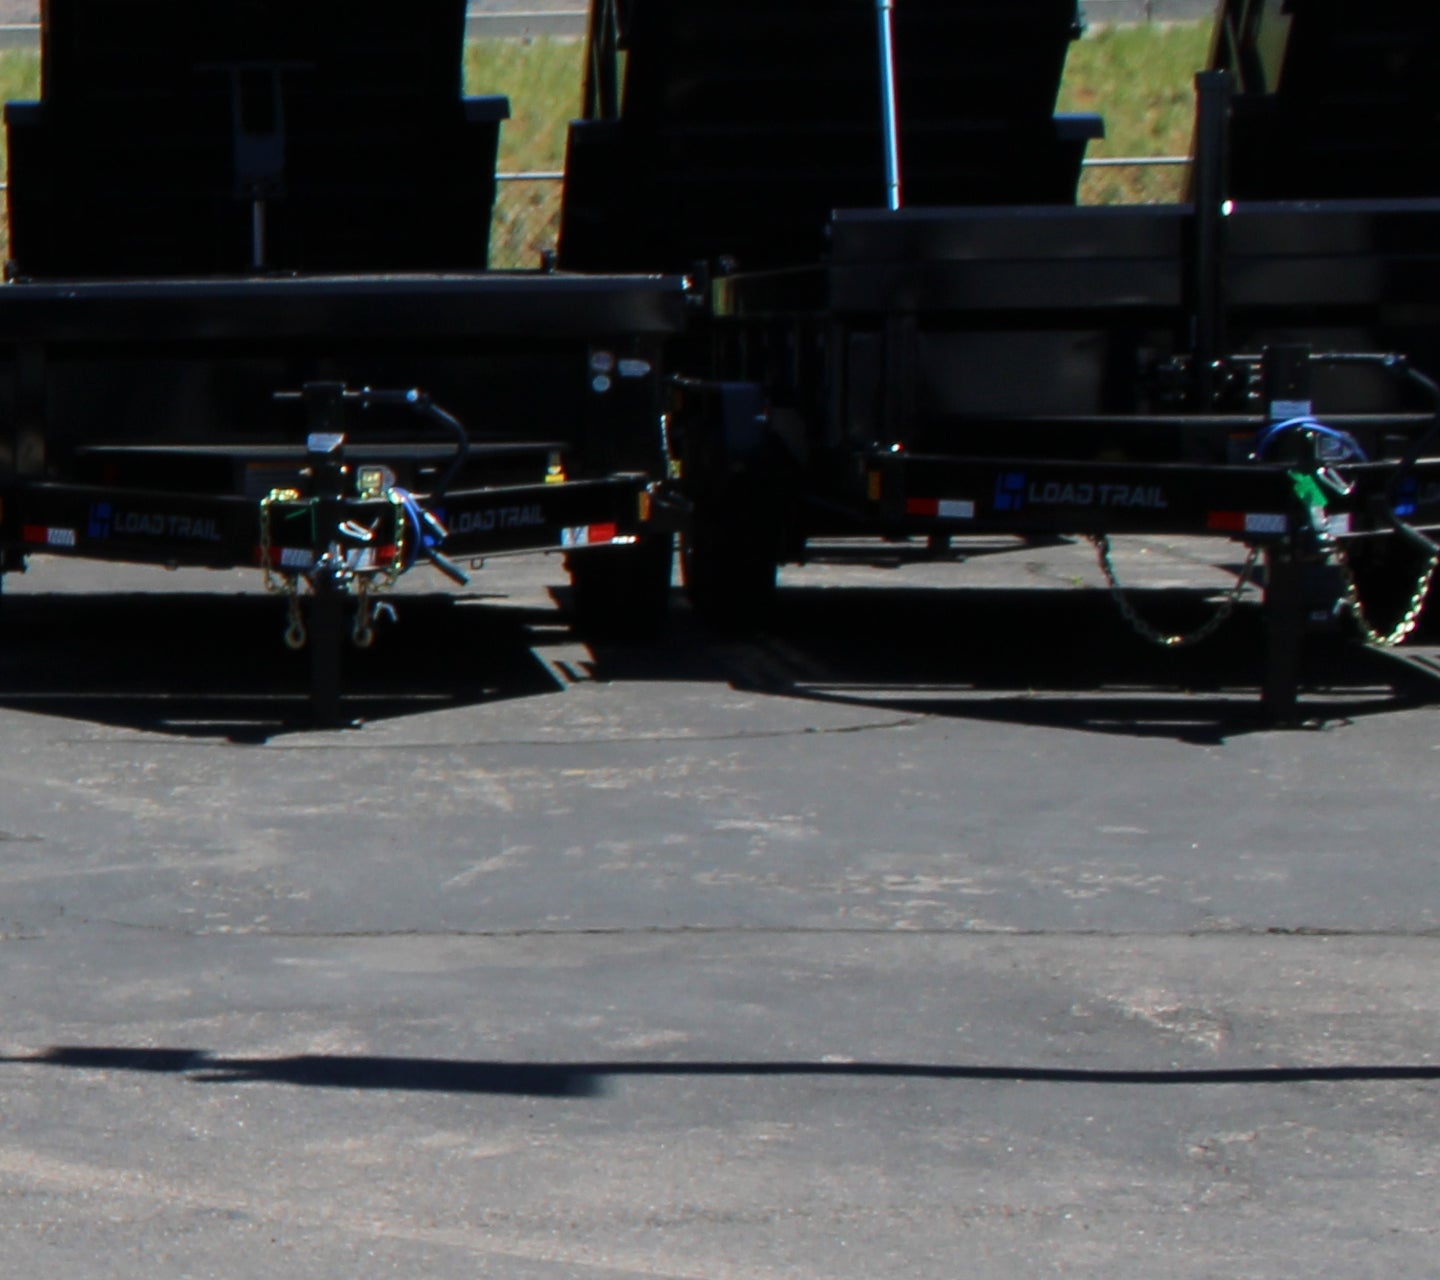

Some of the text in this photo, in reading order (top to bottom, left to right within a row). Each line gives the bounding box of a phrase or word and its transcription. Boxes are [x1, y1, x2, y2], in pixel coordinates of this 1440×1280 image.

[1028, 481, 1169, 509] LOAD TRAIL
[114, 511, 221, 540] LOAD TRAIL
[449, 504, 547, 534] LOAD TRAIL
